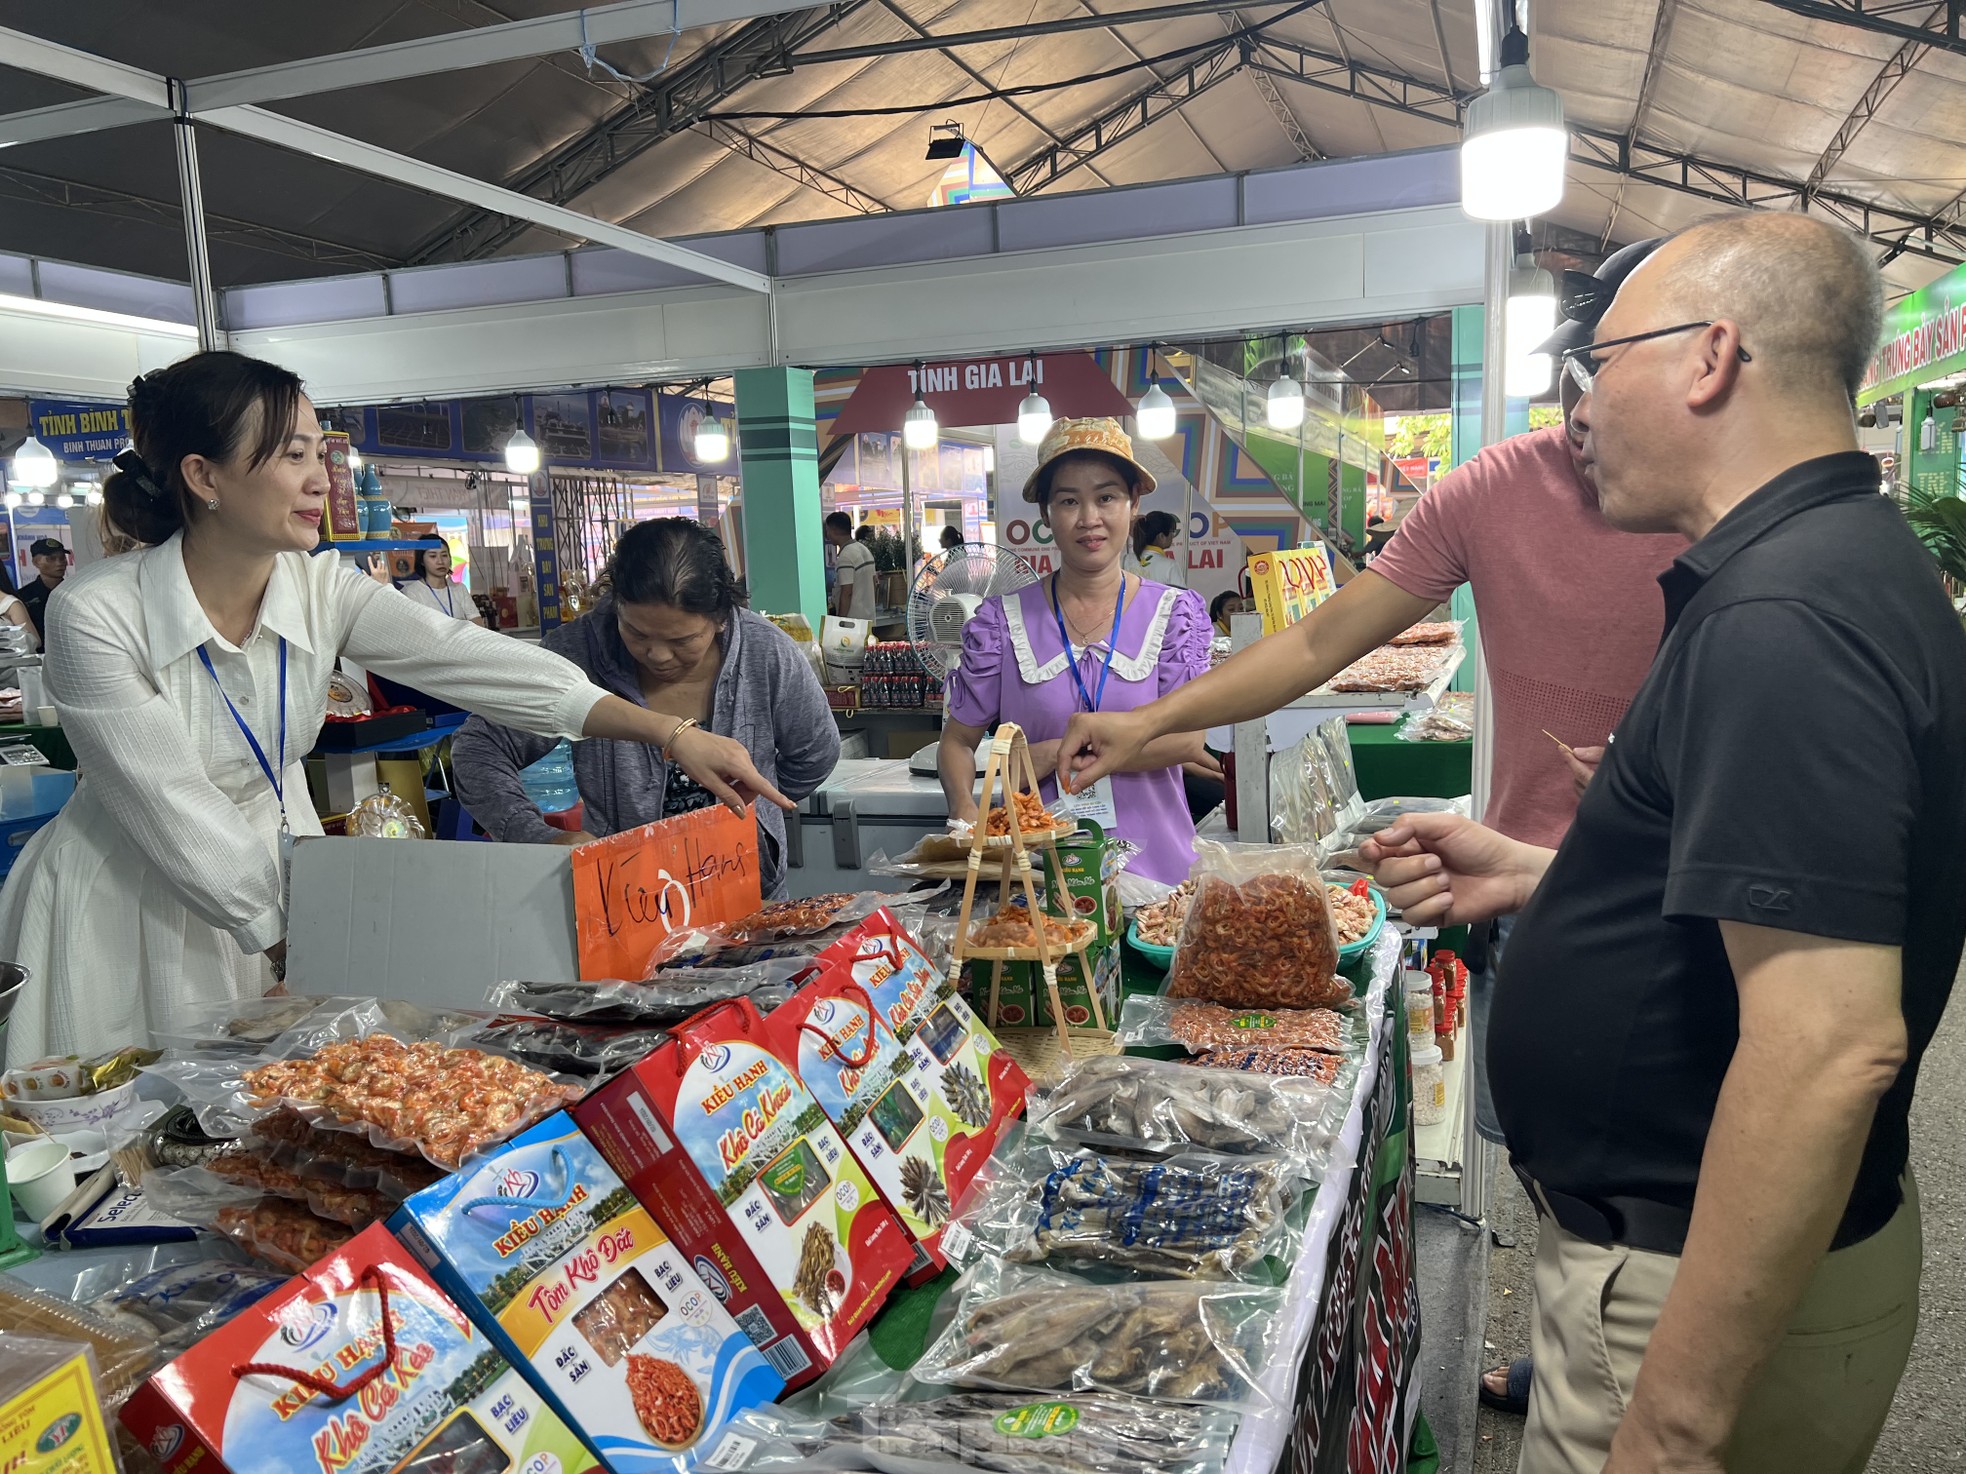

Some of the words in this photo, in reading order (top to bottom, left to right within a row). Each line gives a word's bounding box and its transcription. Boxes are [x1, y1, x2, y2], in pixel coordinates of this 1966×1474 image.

[965, 363, 1002, 390] GIA
[1009, 359, 1043, 386] LAI
[39, 410, 76, 437] TỈNH
[64, 440, 84, 453] BINH
[85, 438, 112, 451] THUAN
[1188, 549, 1223, 569] LAI
[700, 1083, 734, 1114] KIỀU
[733, 1059, 768, 1091] HẠNH
[718, 1128, 750, 1171] Khô
[743, 1109, 766, 1140] Cá
[836, 1181, 852, 1201] OCOP
[744, 1200, 761, 1218] ĐẶC
[755, 1213, 770, 1231] SẢN
[494, 1218, 539, 1256] KIỀU
[711, 1242, 732, 1271] HẠNH
[528, 1285, 569, 1323] Tôm
[564, 1249, 598, 1289] Khô
[598, 1227, 634, 1263] Đất
[728, 1266, 748, 1293] KIỀU
[680, 1292, 702, 1316] OCOP
[554, 1346, 576, 1368] ĐẶC
[568, 1360, 590, 1383] SẢN
[270, 1361, 337, 1421] KIU
[490, 1394, 512, 1418] BẠC
[504, 1408, 527, 1434] LIÊU
[313, 1413, 370, 1474] Khô
